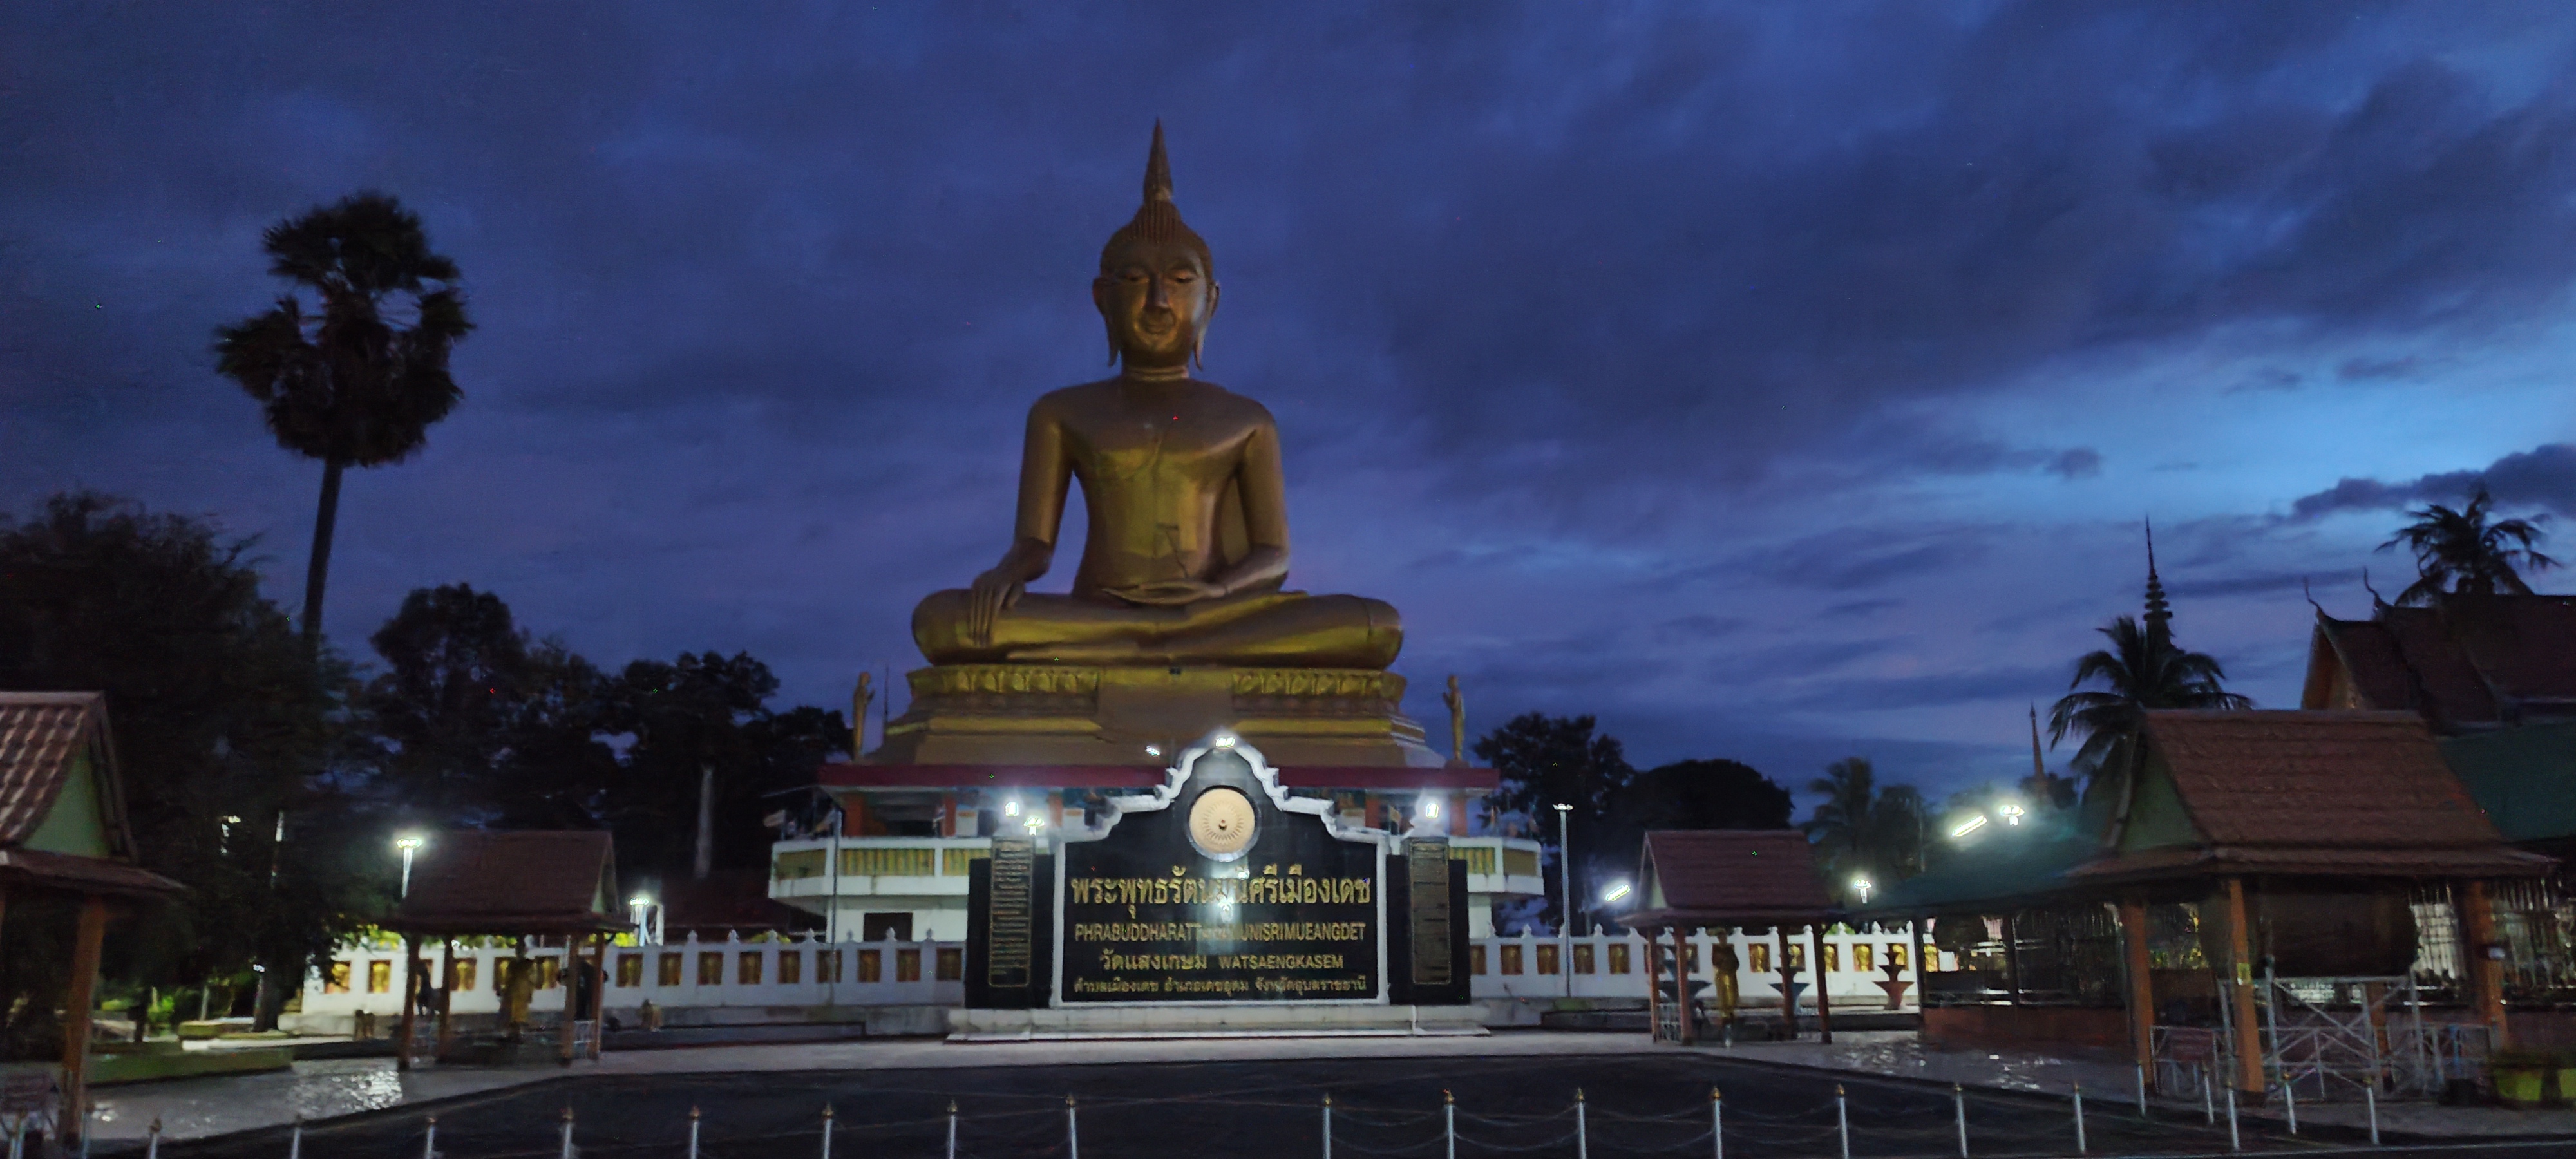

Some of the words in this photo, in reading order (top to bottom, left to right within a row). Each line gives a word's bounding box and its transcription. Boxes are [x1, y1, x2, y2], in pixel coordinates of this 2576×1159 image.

[1070, 863, 1371, 919] พระพุทธรัตนมนีศรีเมืองเดช
[1075, 922, 1367, 941] PHRABUDDHARATTUNISRIMUEANGDET
[1100, 948, 1208, 970] วัดแสงเกษม
[1218, 954, 1344, 970] WATSAENGKASEM
